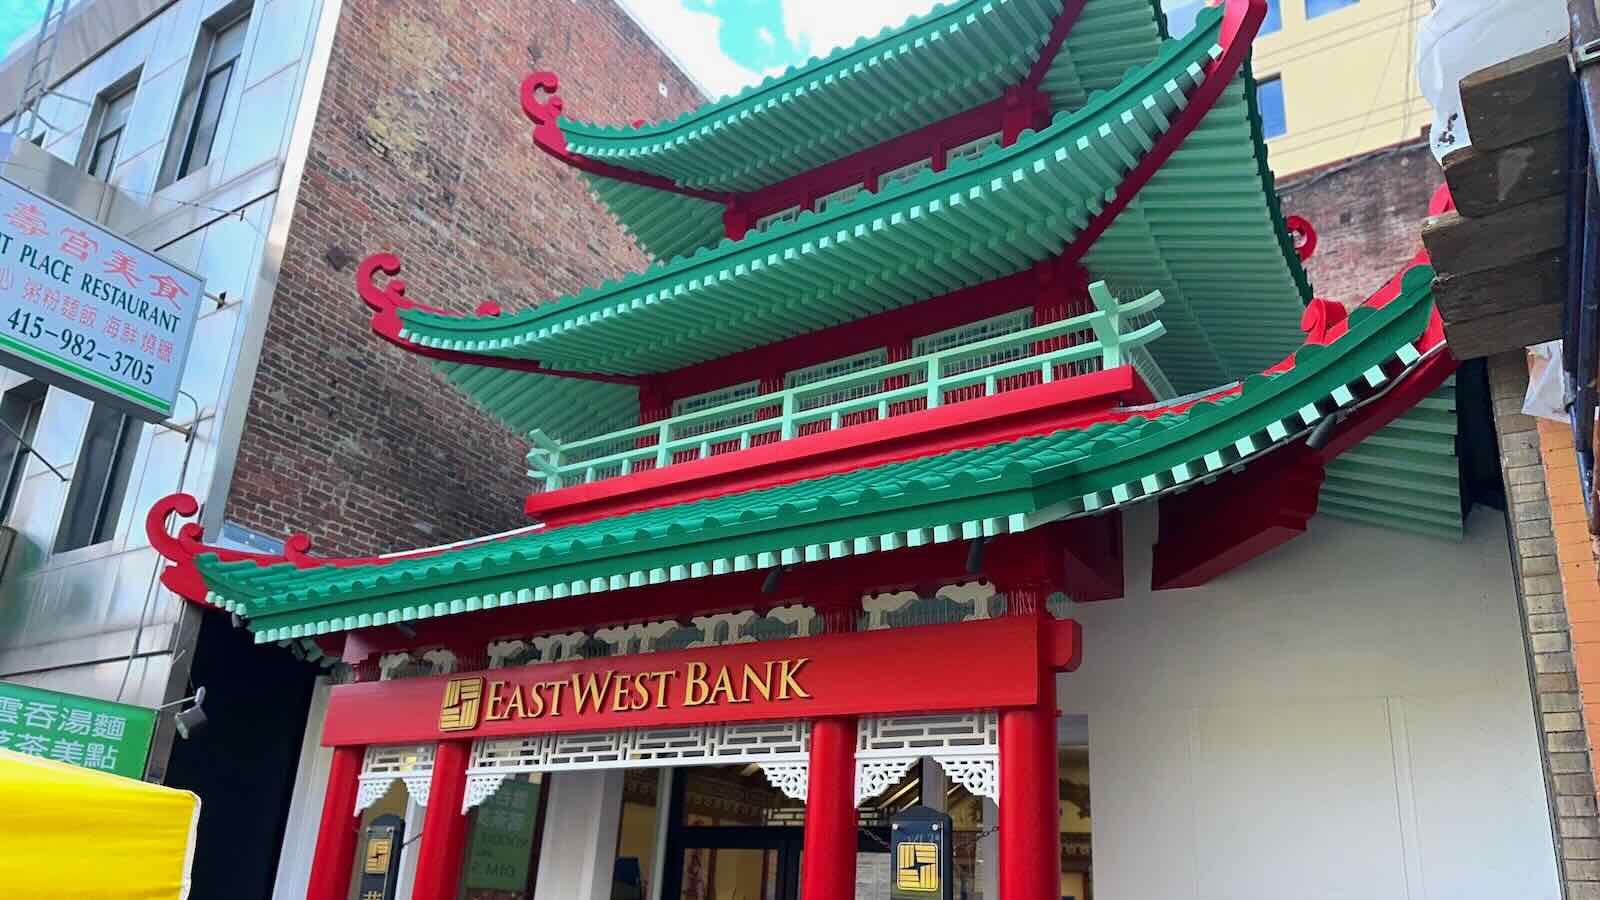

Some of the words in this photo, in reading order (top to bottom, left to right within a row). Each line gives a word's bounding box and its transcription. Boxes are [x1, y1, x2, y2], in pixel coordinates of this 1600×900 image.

[0, 233, 14, 254] T
[20, 244, 74, 284] PLACE
[81, 273, 181, 334] RESTAURANT
[8, 308, 155, 385] 415-982-3705
[682, 658, 812, 707] BANK
